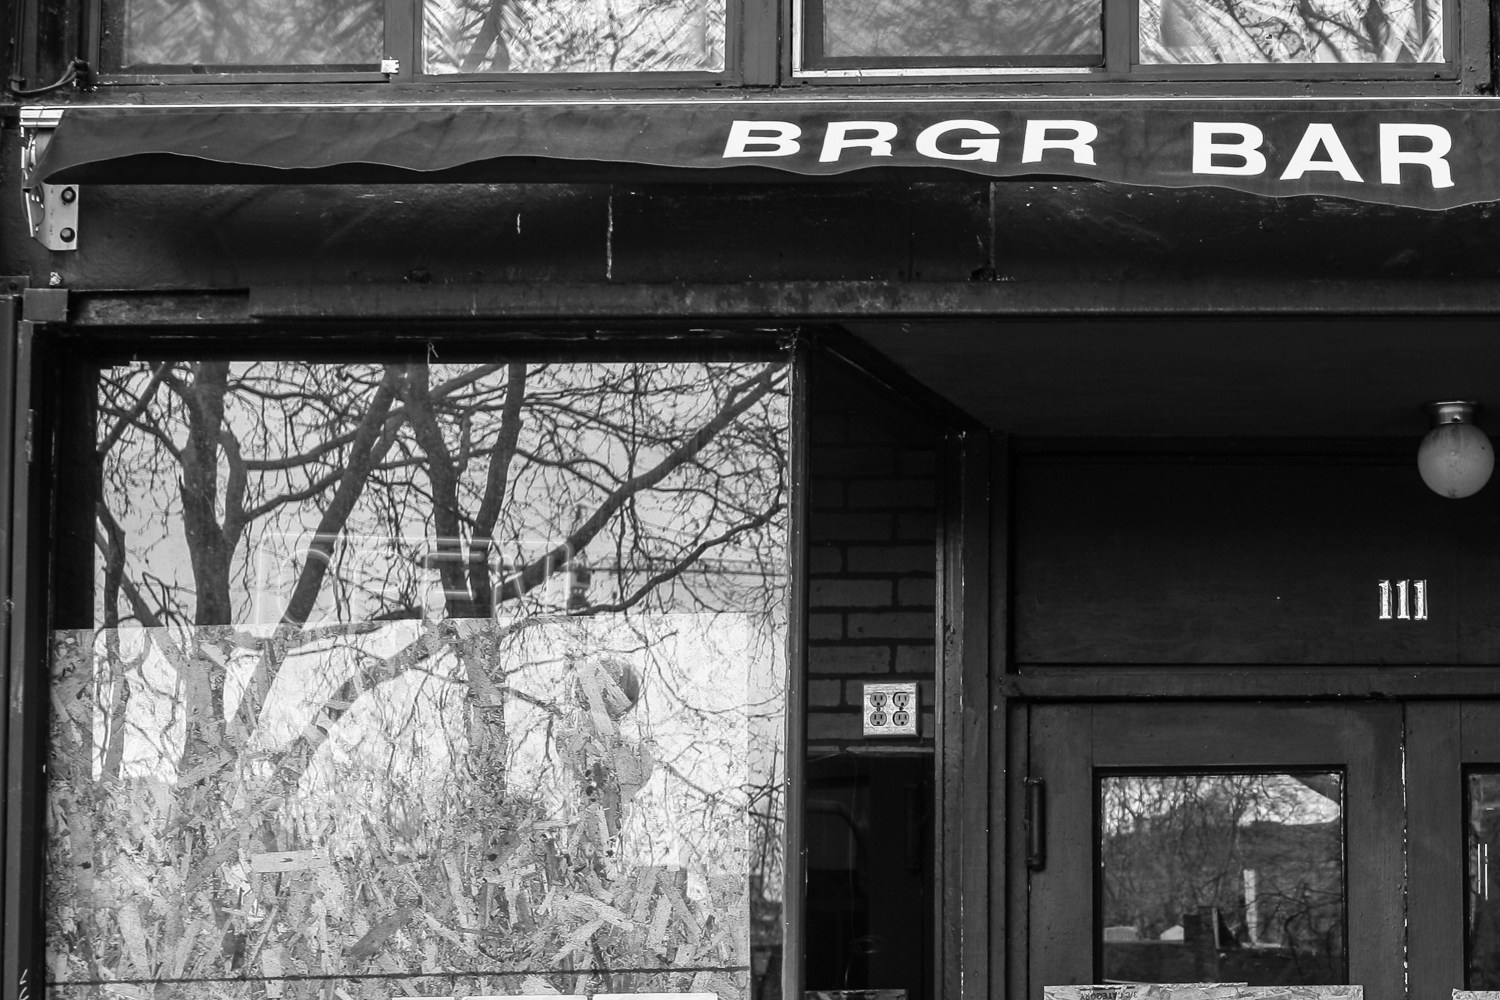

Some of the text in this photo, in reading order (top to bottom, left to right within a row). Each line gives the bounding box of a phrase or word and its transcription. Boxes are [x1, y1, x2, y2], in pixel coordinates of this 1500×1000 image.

[722, 119, 1455, 189] BRGR BAR
[1378, 579, 1428, 621] 111
